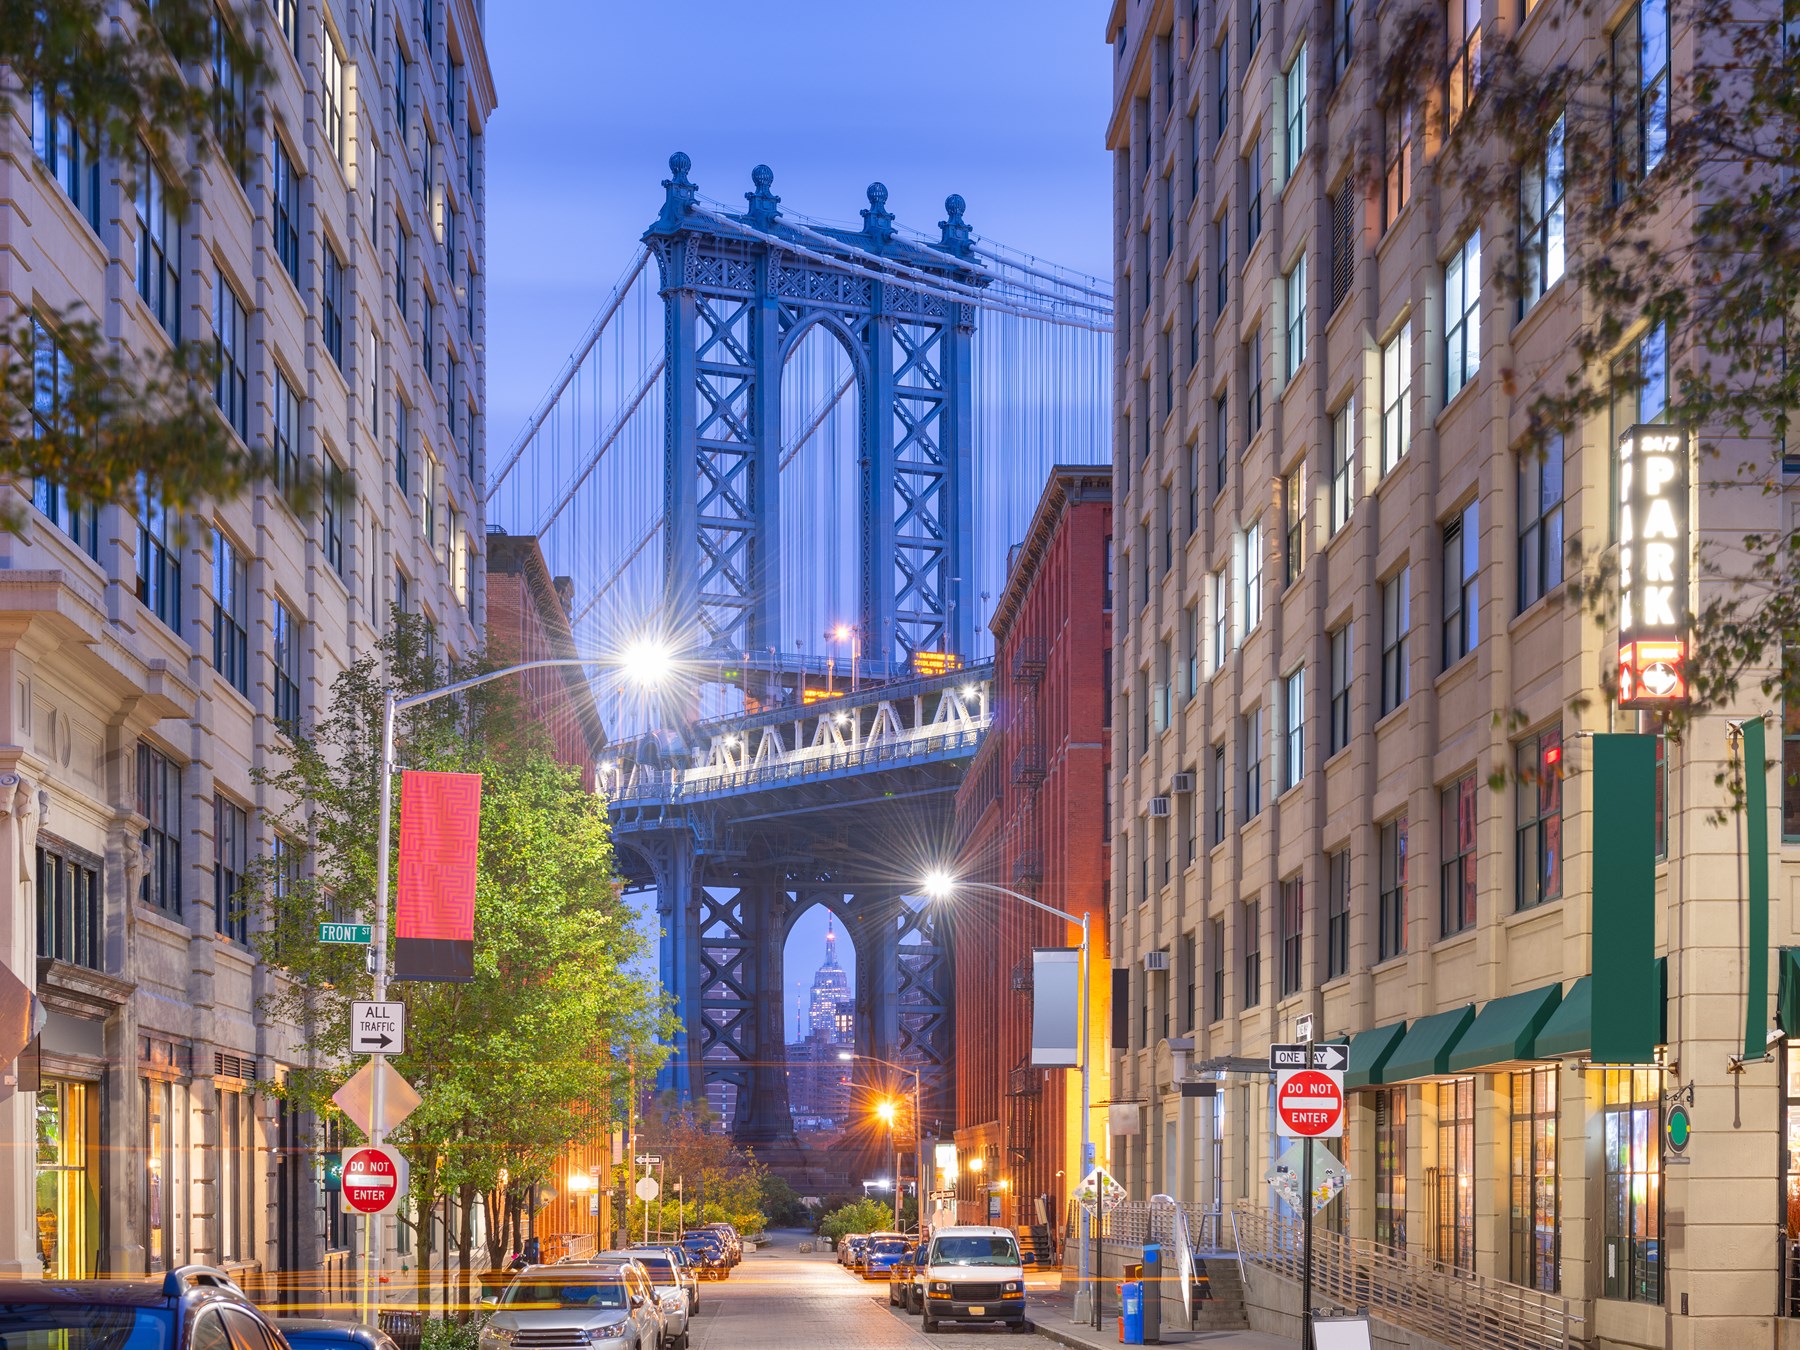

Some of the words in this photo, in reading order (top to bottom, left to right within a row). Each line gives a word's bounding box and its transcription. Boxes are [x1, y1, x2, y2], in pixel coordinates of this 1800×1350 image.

[1643, 456, 1678, 626] PARK
[322, 925, 357, 941] FRONT
[362, 926, 370, 935] ST
[365, 1006, 390, 1018] ALL
[360, 1021, 395, 1032] TRAFFIC
[1279, 1052, 1300, 1062] ONE
[1305, 1053, 1325, 1062] AY
[1288, 1083, 1304, 1094] DO
[1310, 1083, 1333, 1094] NOT
[1291, 1112, 1328, 1123] ENTER
[350, 1161, 364, 1172] DO
[370, 1162, 389, 1172] NOT
[354, 1190, 384, 1200] ENTER
